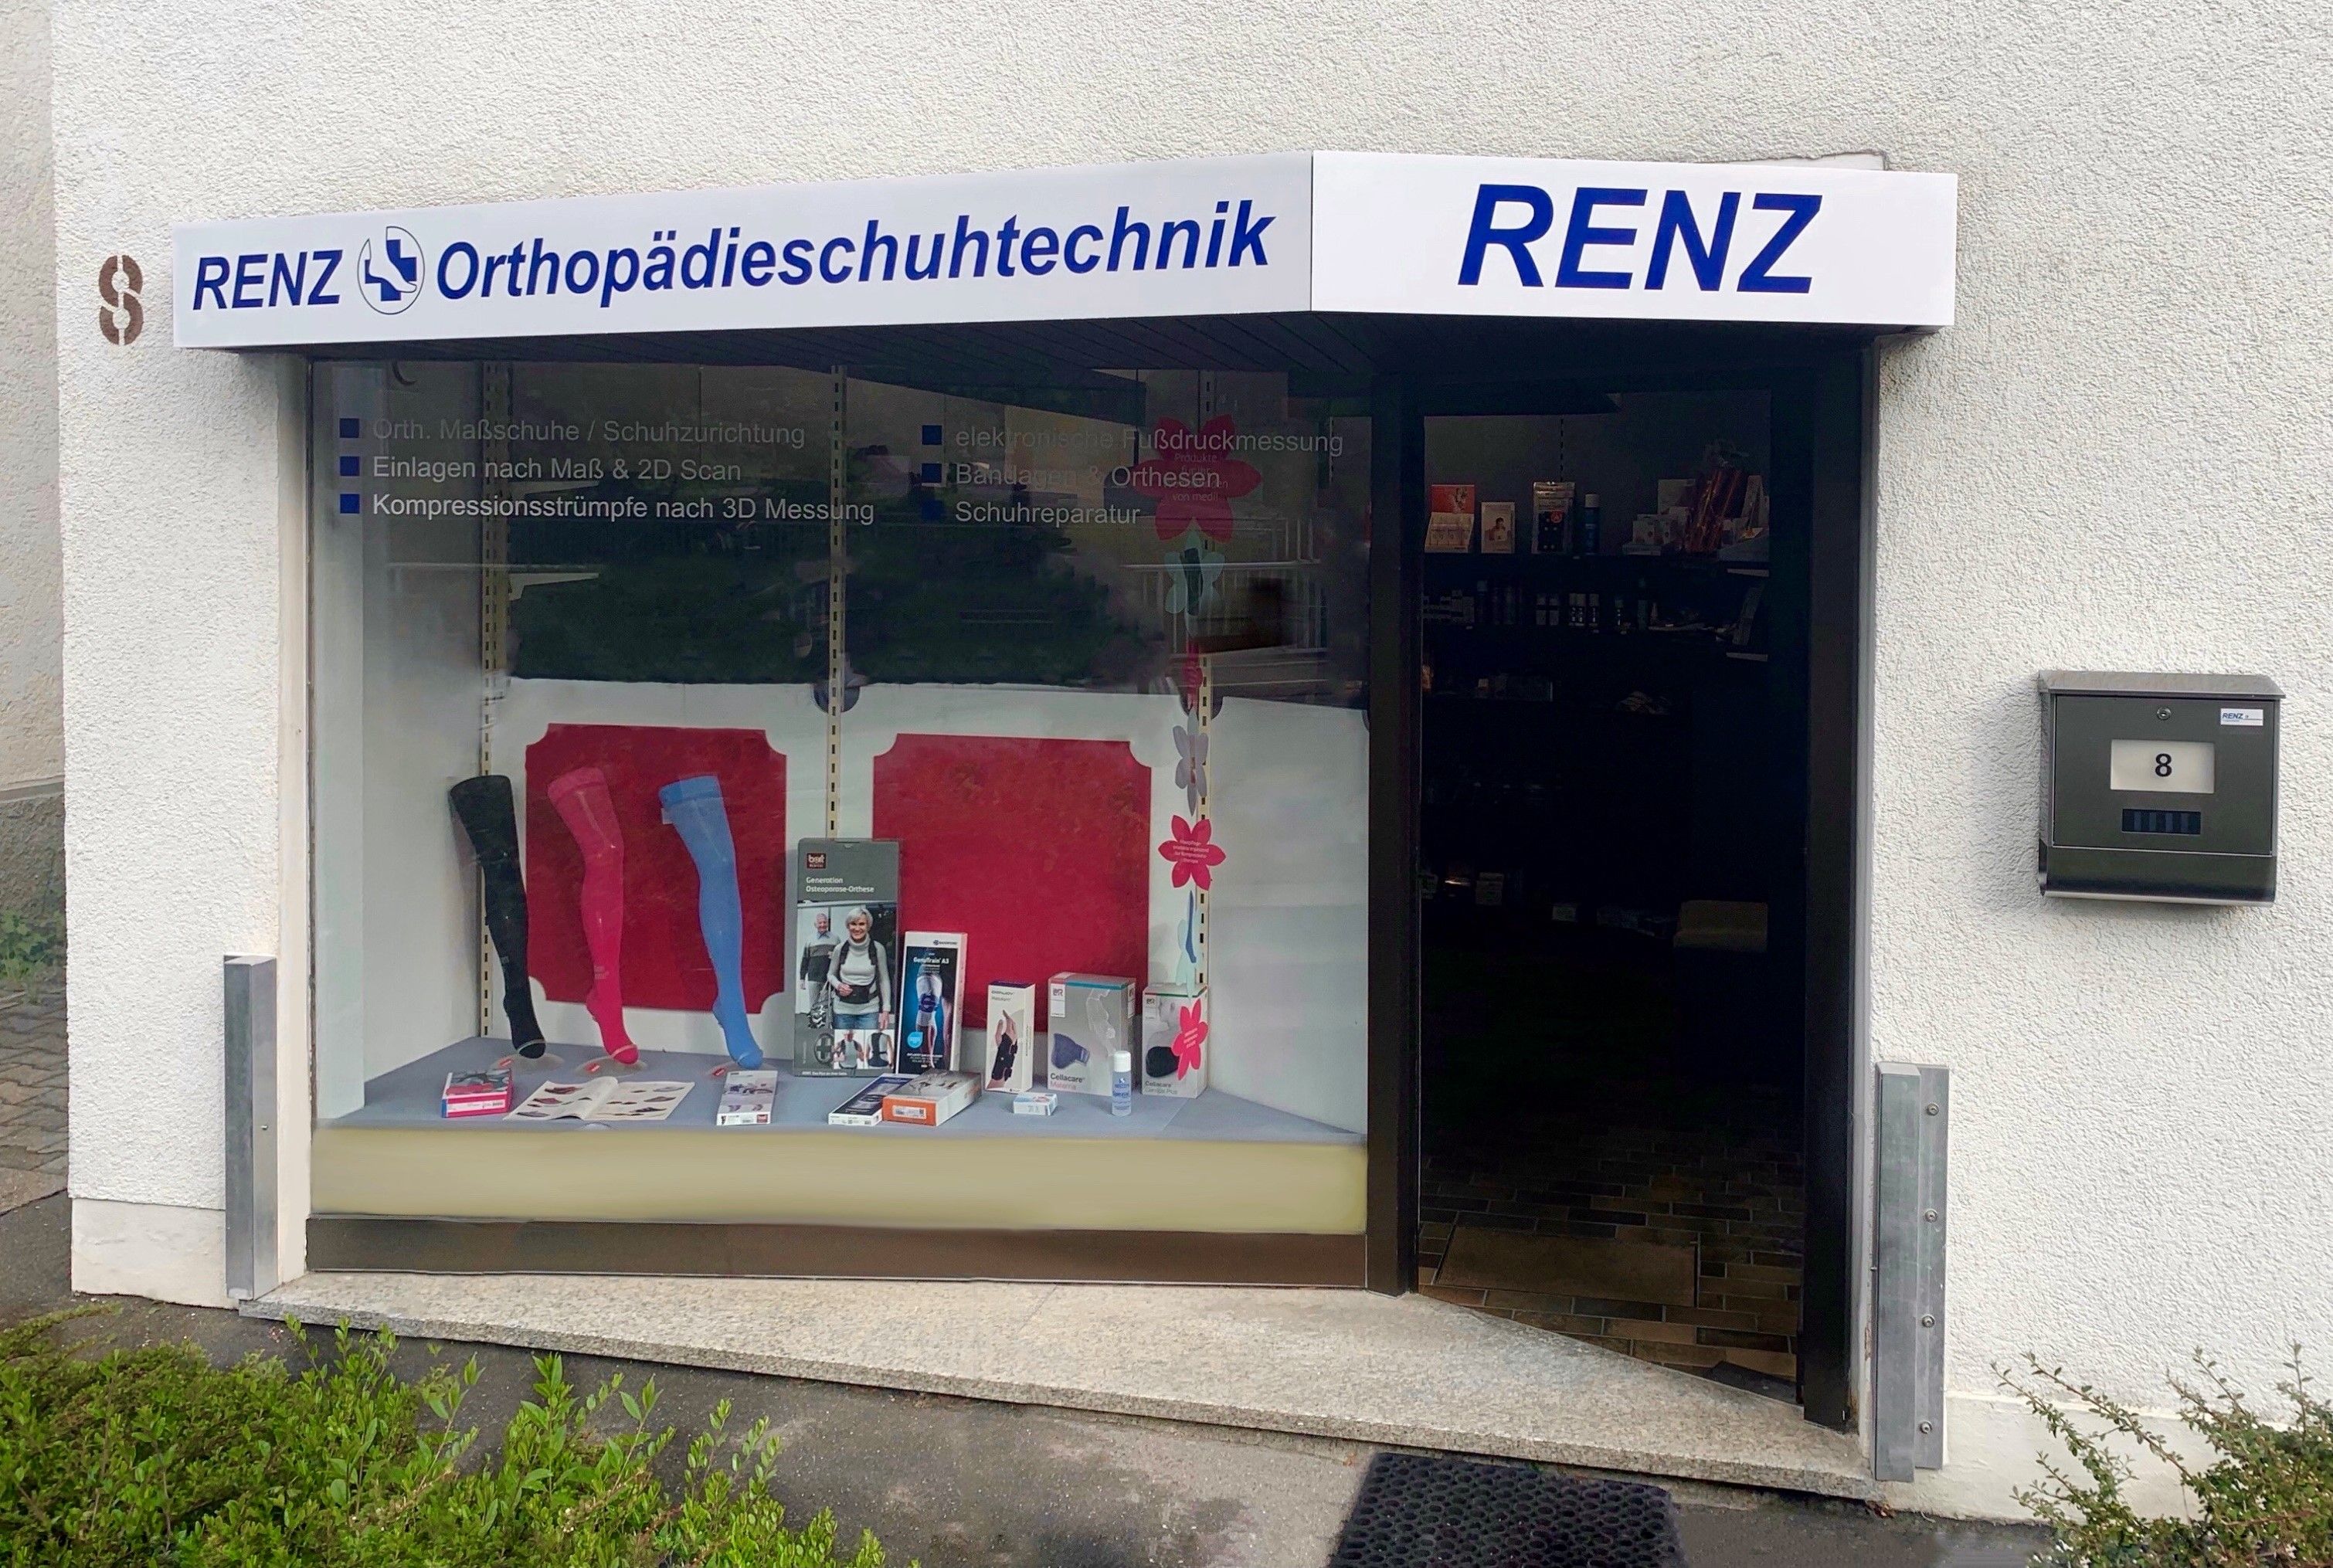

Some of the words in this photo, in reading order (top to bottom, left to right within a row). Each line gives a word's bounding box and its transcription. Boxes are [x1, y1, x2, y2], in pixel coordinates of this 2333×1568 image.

[1457, 184, 1823, 294] RENZ
[193, 249, 343, 310] RENZ
[437, 200, 1276, 307] Orthopädieschuhtechnik
[374, 419, 430, 440] Orth.
[440, 419, 579, 441] Maßschuhe
[603, 420, 806, 449] Schuhzurichtung
[1122, 427, 1343, 457] Fußdruckmessung
[374, 456, 476, 483] Einlagen
[485, 457, 542, 479] nach
[551, 458, 605, 479] Maß
[612, 459, 630, 480] &
[638, 459, 672, 480] 2D
[681, 459, 742, 481] Scan
[1112, 466, 1220, 488] Orthesen
[374, 494, 647, 522] Kompressionsstrümpfe
[657, 497, 714, 518] nach
[722, 498, 756, 519] 3D
[765, 498, 874, 525] Messung
[956, 501, 1140, 528] Schuhreparatur
[2155, 753, 2172, 777] 8
[806, 885, 874, 894] Osteoporose-Orthese
